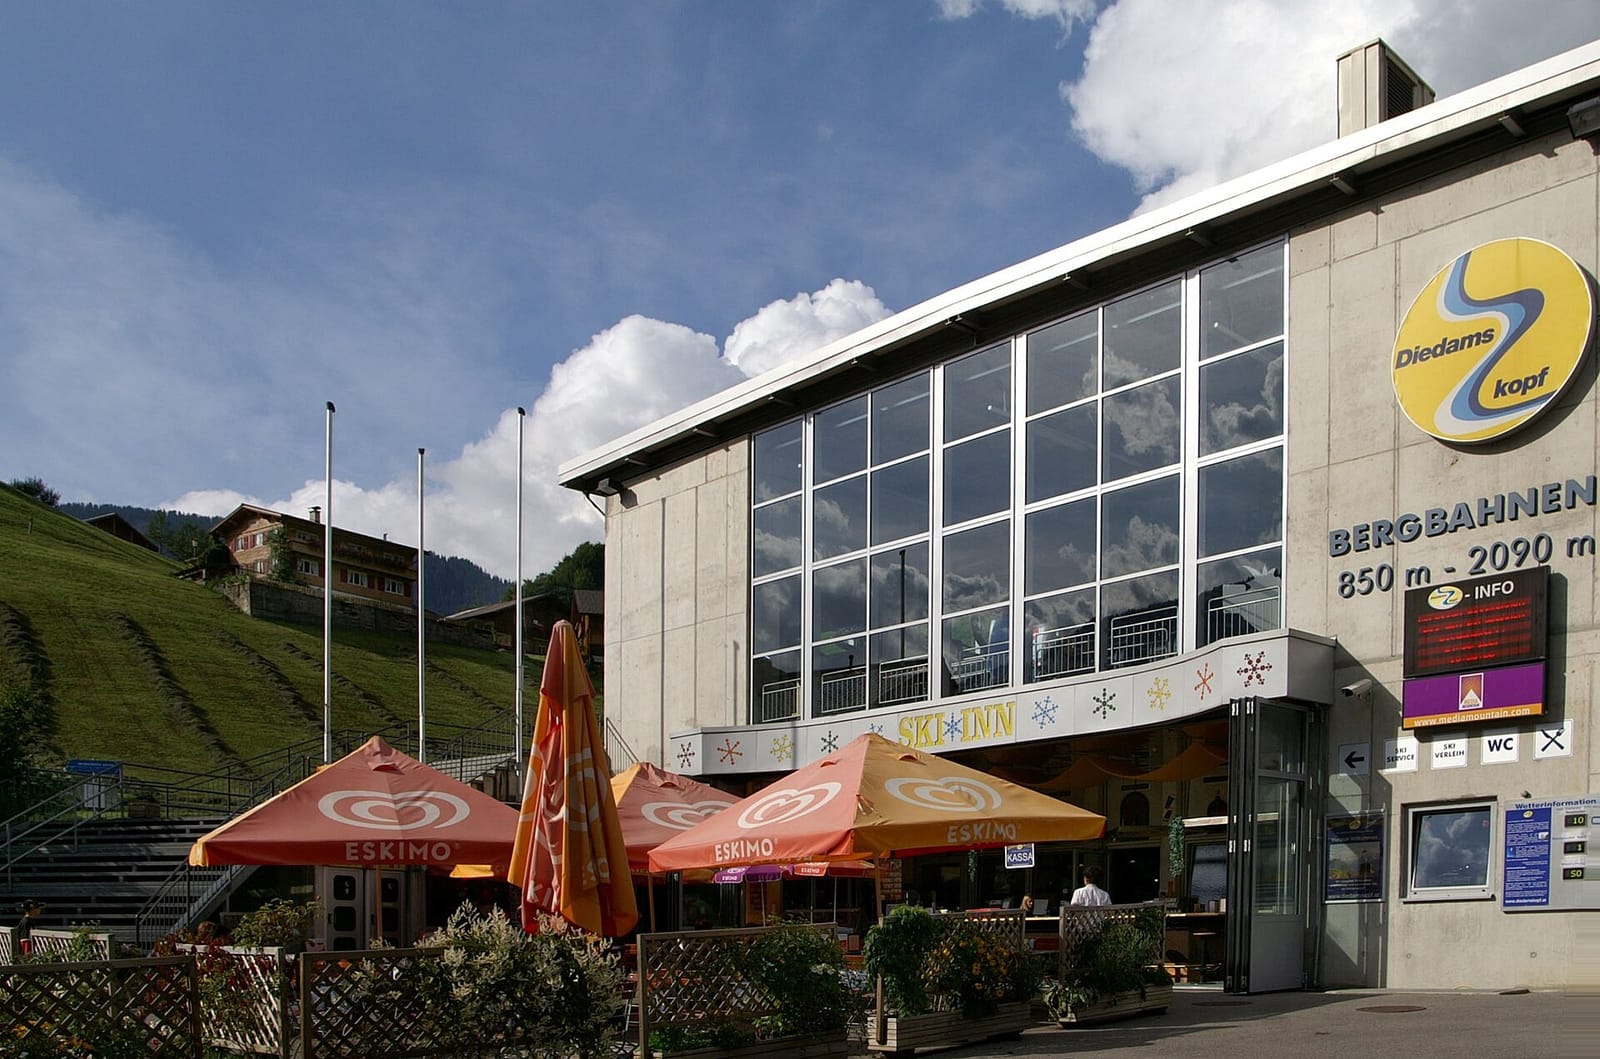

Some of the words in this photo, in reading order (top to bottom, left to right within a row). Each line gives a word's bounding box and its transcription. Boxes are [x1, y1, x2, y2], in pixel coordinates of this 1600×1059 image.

[1395, 327, 1495, 369] Diedams
[1493, 367, 1550, 399] kopf
[1329, 474, 1598, 557] BERGBAHNEN
[1338, 563, 1394, 598] 850
[1405, 565, 1431, 587] m
[1468, 533, 1553, 575] 2090
[1566, 535, 1596, 558] m
[1474, 580, 1515, 600] INFO
[898, 712, 946, 749] SKI
[960, 701, 1016, 743] INN
[1413, 707, 1531, 727] www.mediamountain.com
[1395, 747, 1407, 755] SKI
[1434, 750, 1465, 759] VERLEIH
[1443, 743, 1456, 751] SKI
[1488, 737, 1514, 753] WC
[1386, 754, 1415, 763] SERVICE
[1515, 799, 1597, 809] Wetterinformation
[1573, 816, 1584, 825] 10
[947, 822, 1017, 843] ESKIMO
[345, 841, 452, 861] ESKIMO
[714, 838, 774, 862] ESKIMO
[1007, 851, 1033, 863] KASSA
